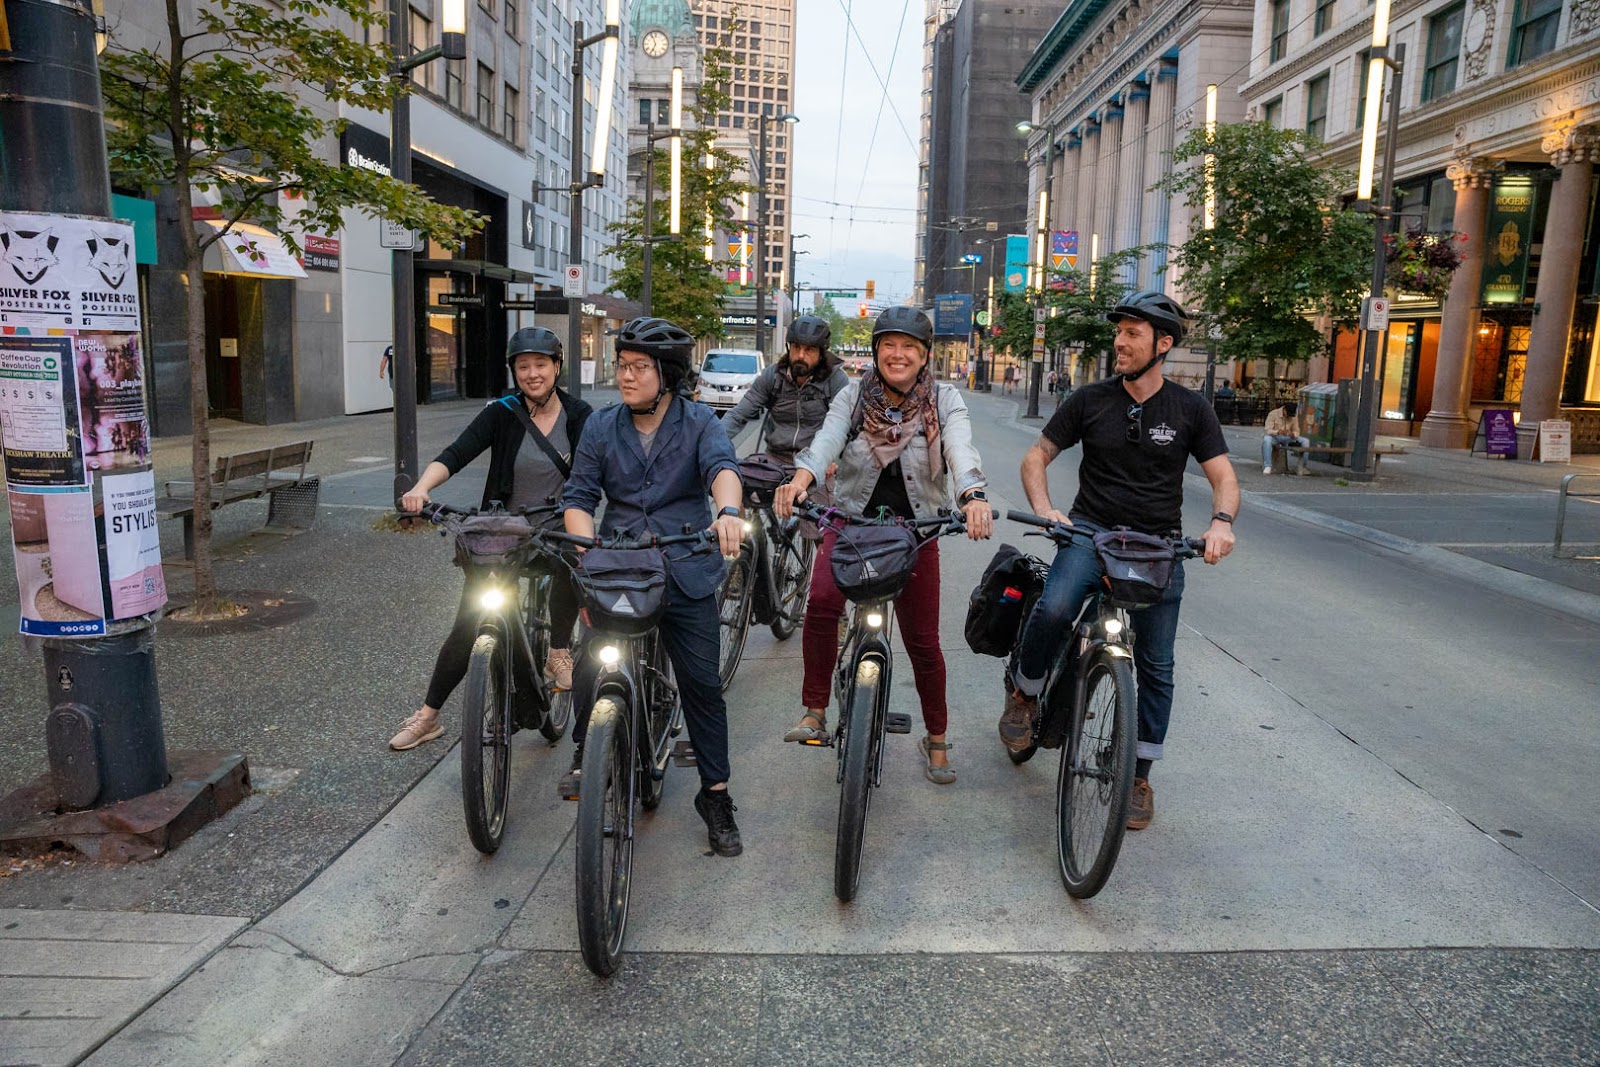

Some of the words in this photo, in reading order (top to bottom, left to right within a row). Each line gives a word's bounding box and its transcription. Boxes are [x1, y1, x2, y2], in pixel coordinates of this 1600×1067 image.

[358, 154, 390, 177] BrainStation
[1496, 196, 1531, 206] ROGERS
[1498, 205, 1528, 213] BUILDING
[1498, 274, 1512, 284] 470
[0, 287, 38, 299] SILVER
[42, 289, 71, 301] FOX
[81, 291, 120, 303] SILVER
[0, 301, 71, 310] POSTERING
[1, 361, 41, 370] Revolution
[35, 451, 73, 459] THEATRE
[112, 501, 127, 511] YOU
[128, 498, 148, 509] SHOULD
[112, 508, 156, 534] STYLIS
